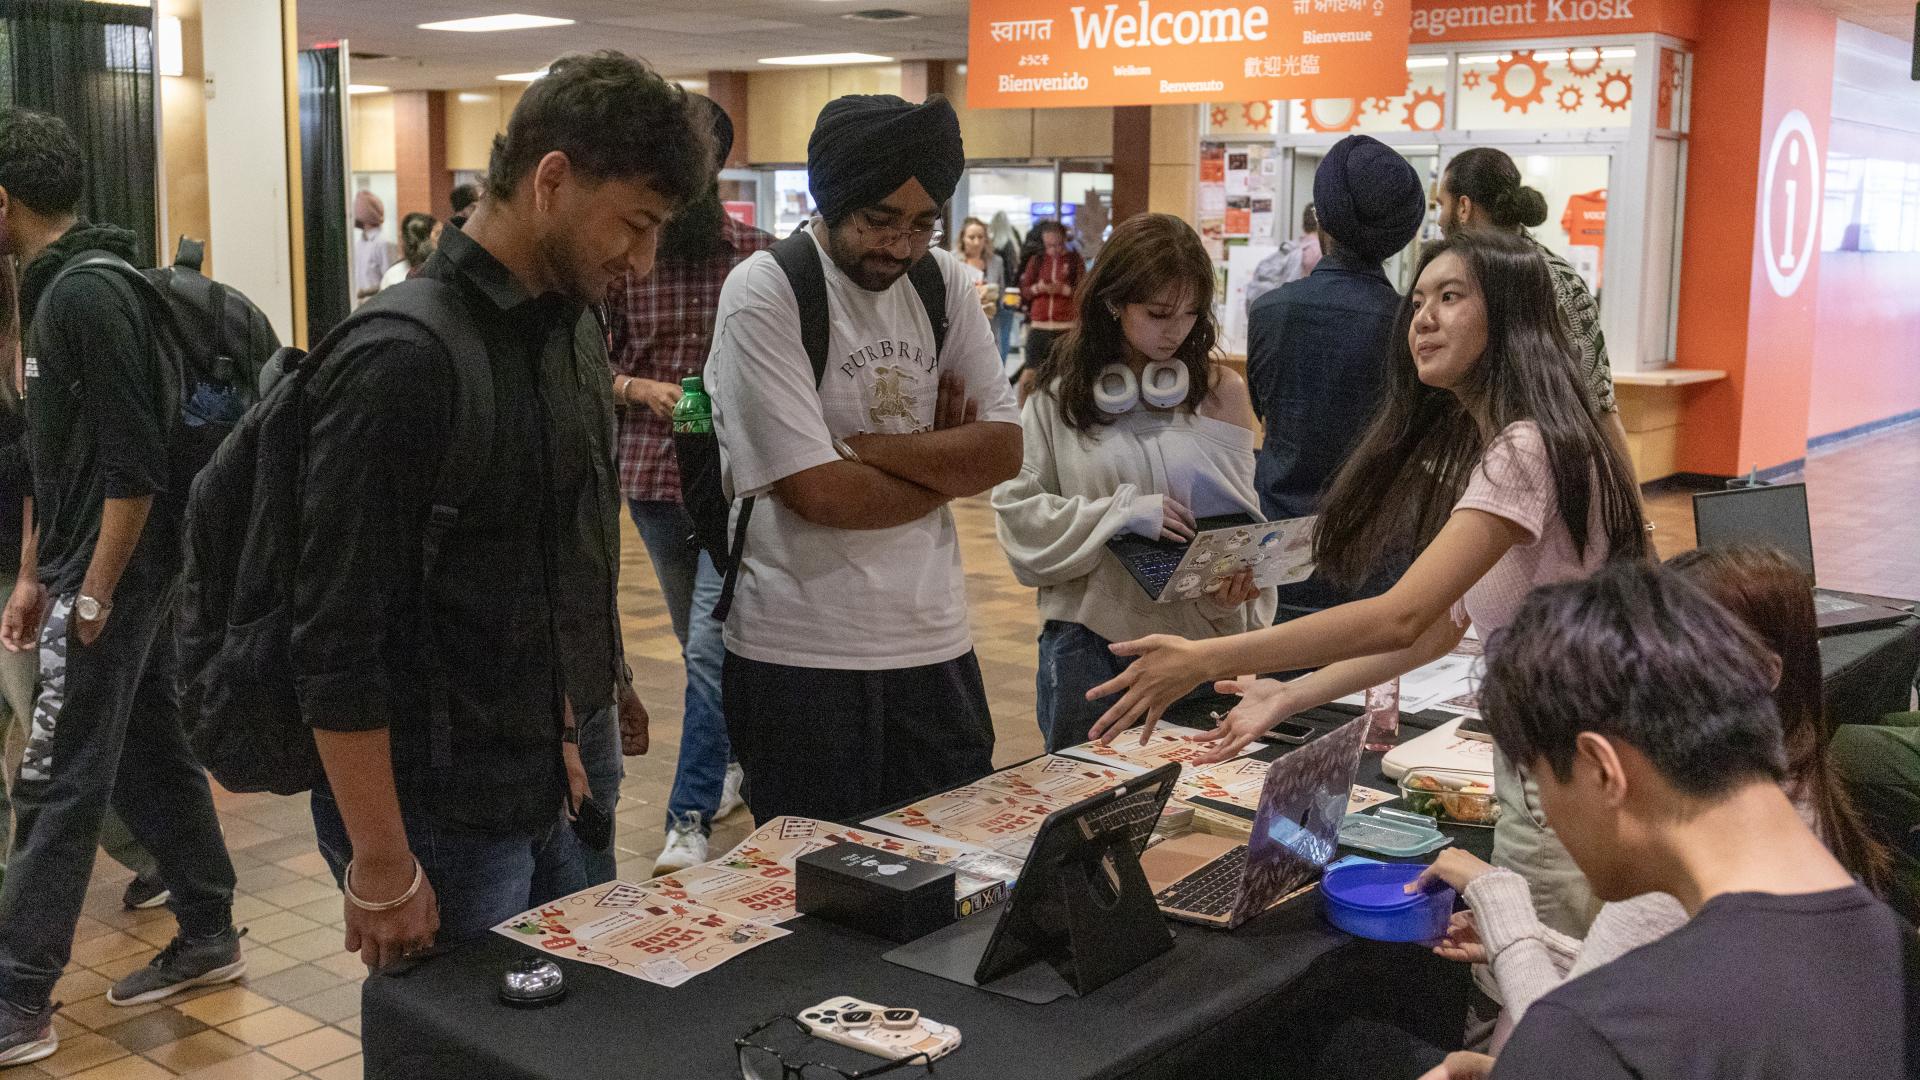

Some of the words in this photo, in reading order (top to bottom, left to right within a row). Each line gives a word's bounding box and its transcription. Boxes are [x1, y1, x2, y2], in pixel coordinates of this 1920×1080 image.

[1070, 1, 1269, 49] Welcome
[1409, 2, 1536, 36] agement
[1546, 0, 1634, 22] Kiosk
[990, 19, 1054, 42] स्वागत
[1302, 30, 1373, 44] Bienvenue
[1244, 54, 1320, 78] 歡迎光臨
[998, 71, 1088, 92] Bienvenido
[1159, 79, 1224, 93] Benvenuto
[737, 886, 787, 904] CLUB
[748, 888, 797, 911] AAG
[631, 926, 682, 949] CLUB
[643, 928, 704, 954] LAAG
